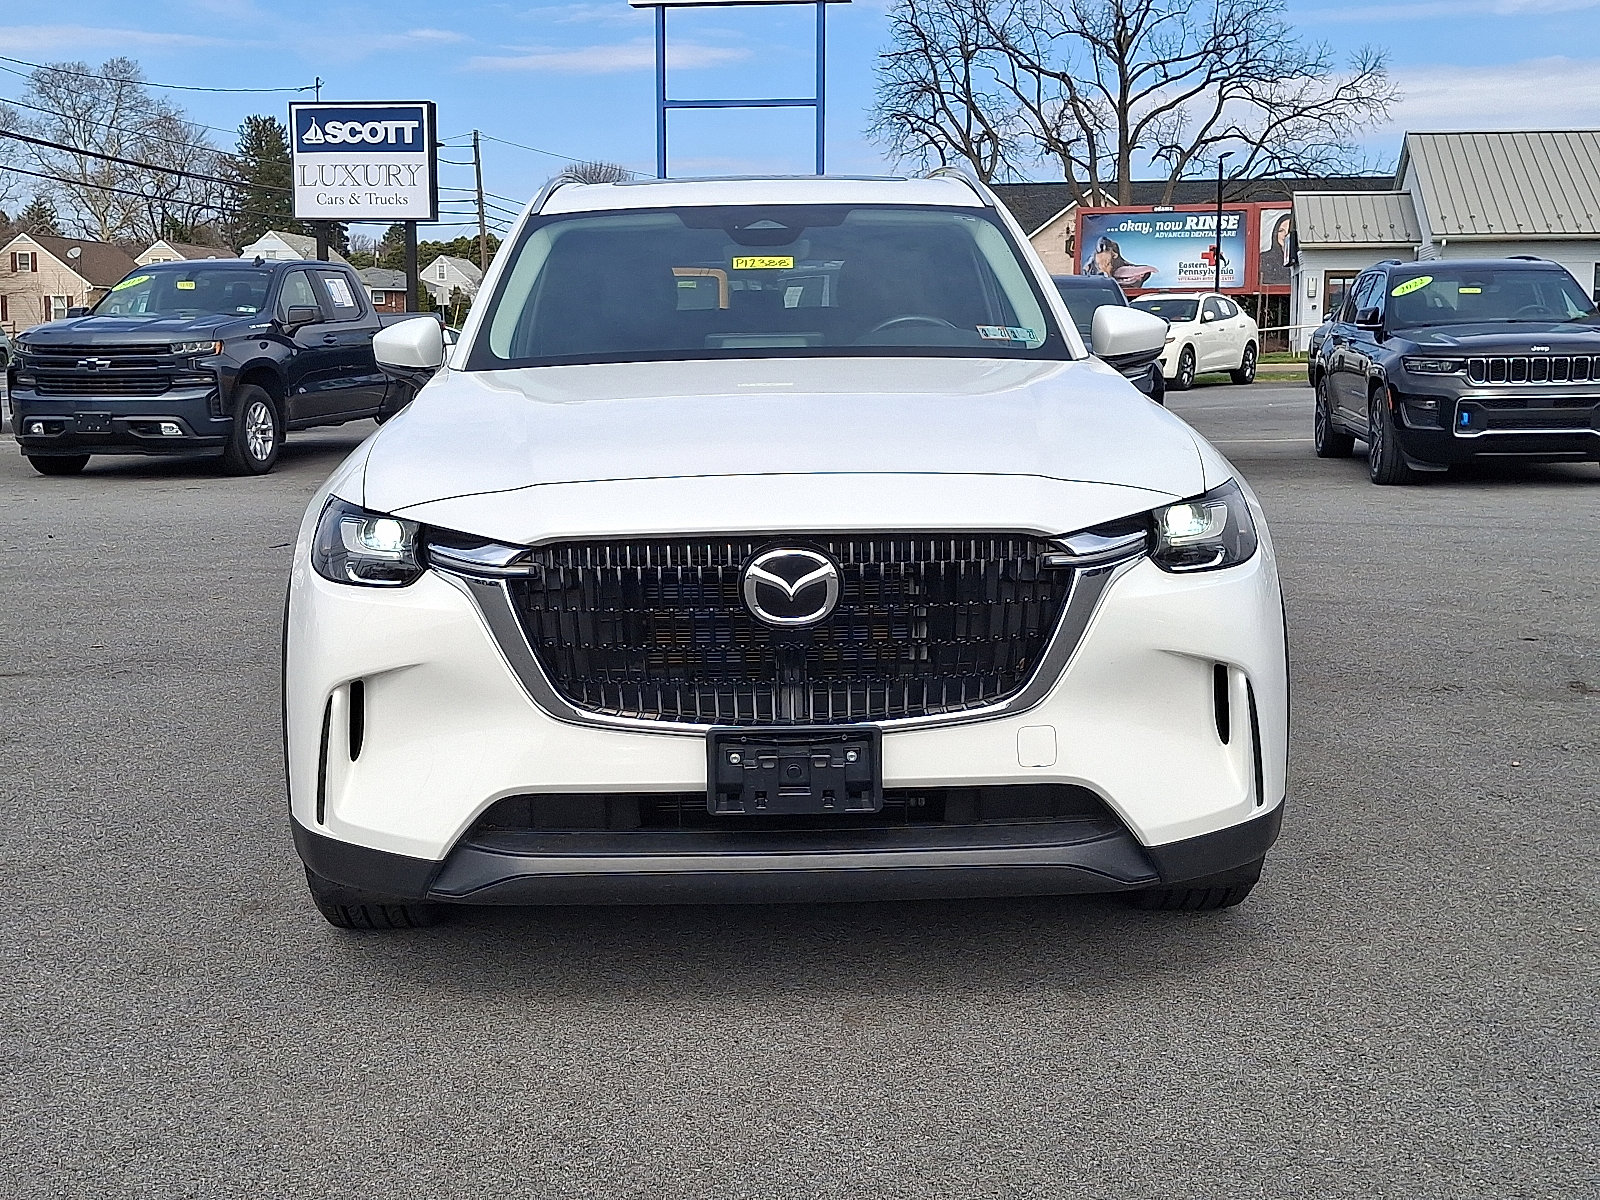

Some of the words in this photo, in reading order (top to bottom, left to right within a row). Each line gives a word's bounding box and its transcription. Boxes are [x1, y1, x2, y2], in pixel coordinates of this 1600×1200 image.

[324, 120, 419, 144] SCOTT
[299, 164, 424, 187] LUXURY
[316, 192, 345, 206] Cars
[349, 192, 361, 206] &
[365, 192, 409, 206] Trucks
[1155, 221, 1183, 230] now
[1184, 214, 1240, 230] RINSE
[1154, 230, 1190, 238] ADVANCED
[1178, 261, 1208, 269] Eastern
[1178, 268, 1234, 276] Pennsylvnia
[1530, 345, 1550, 353] Jeep
